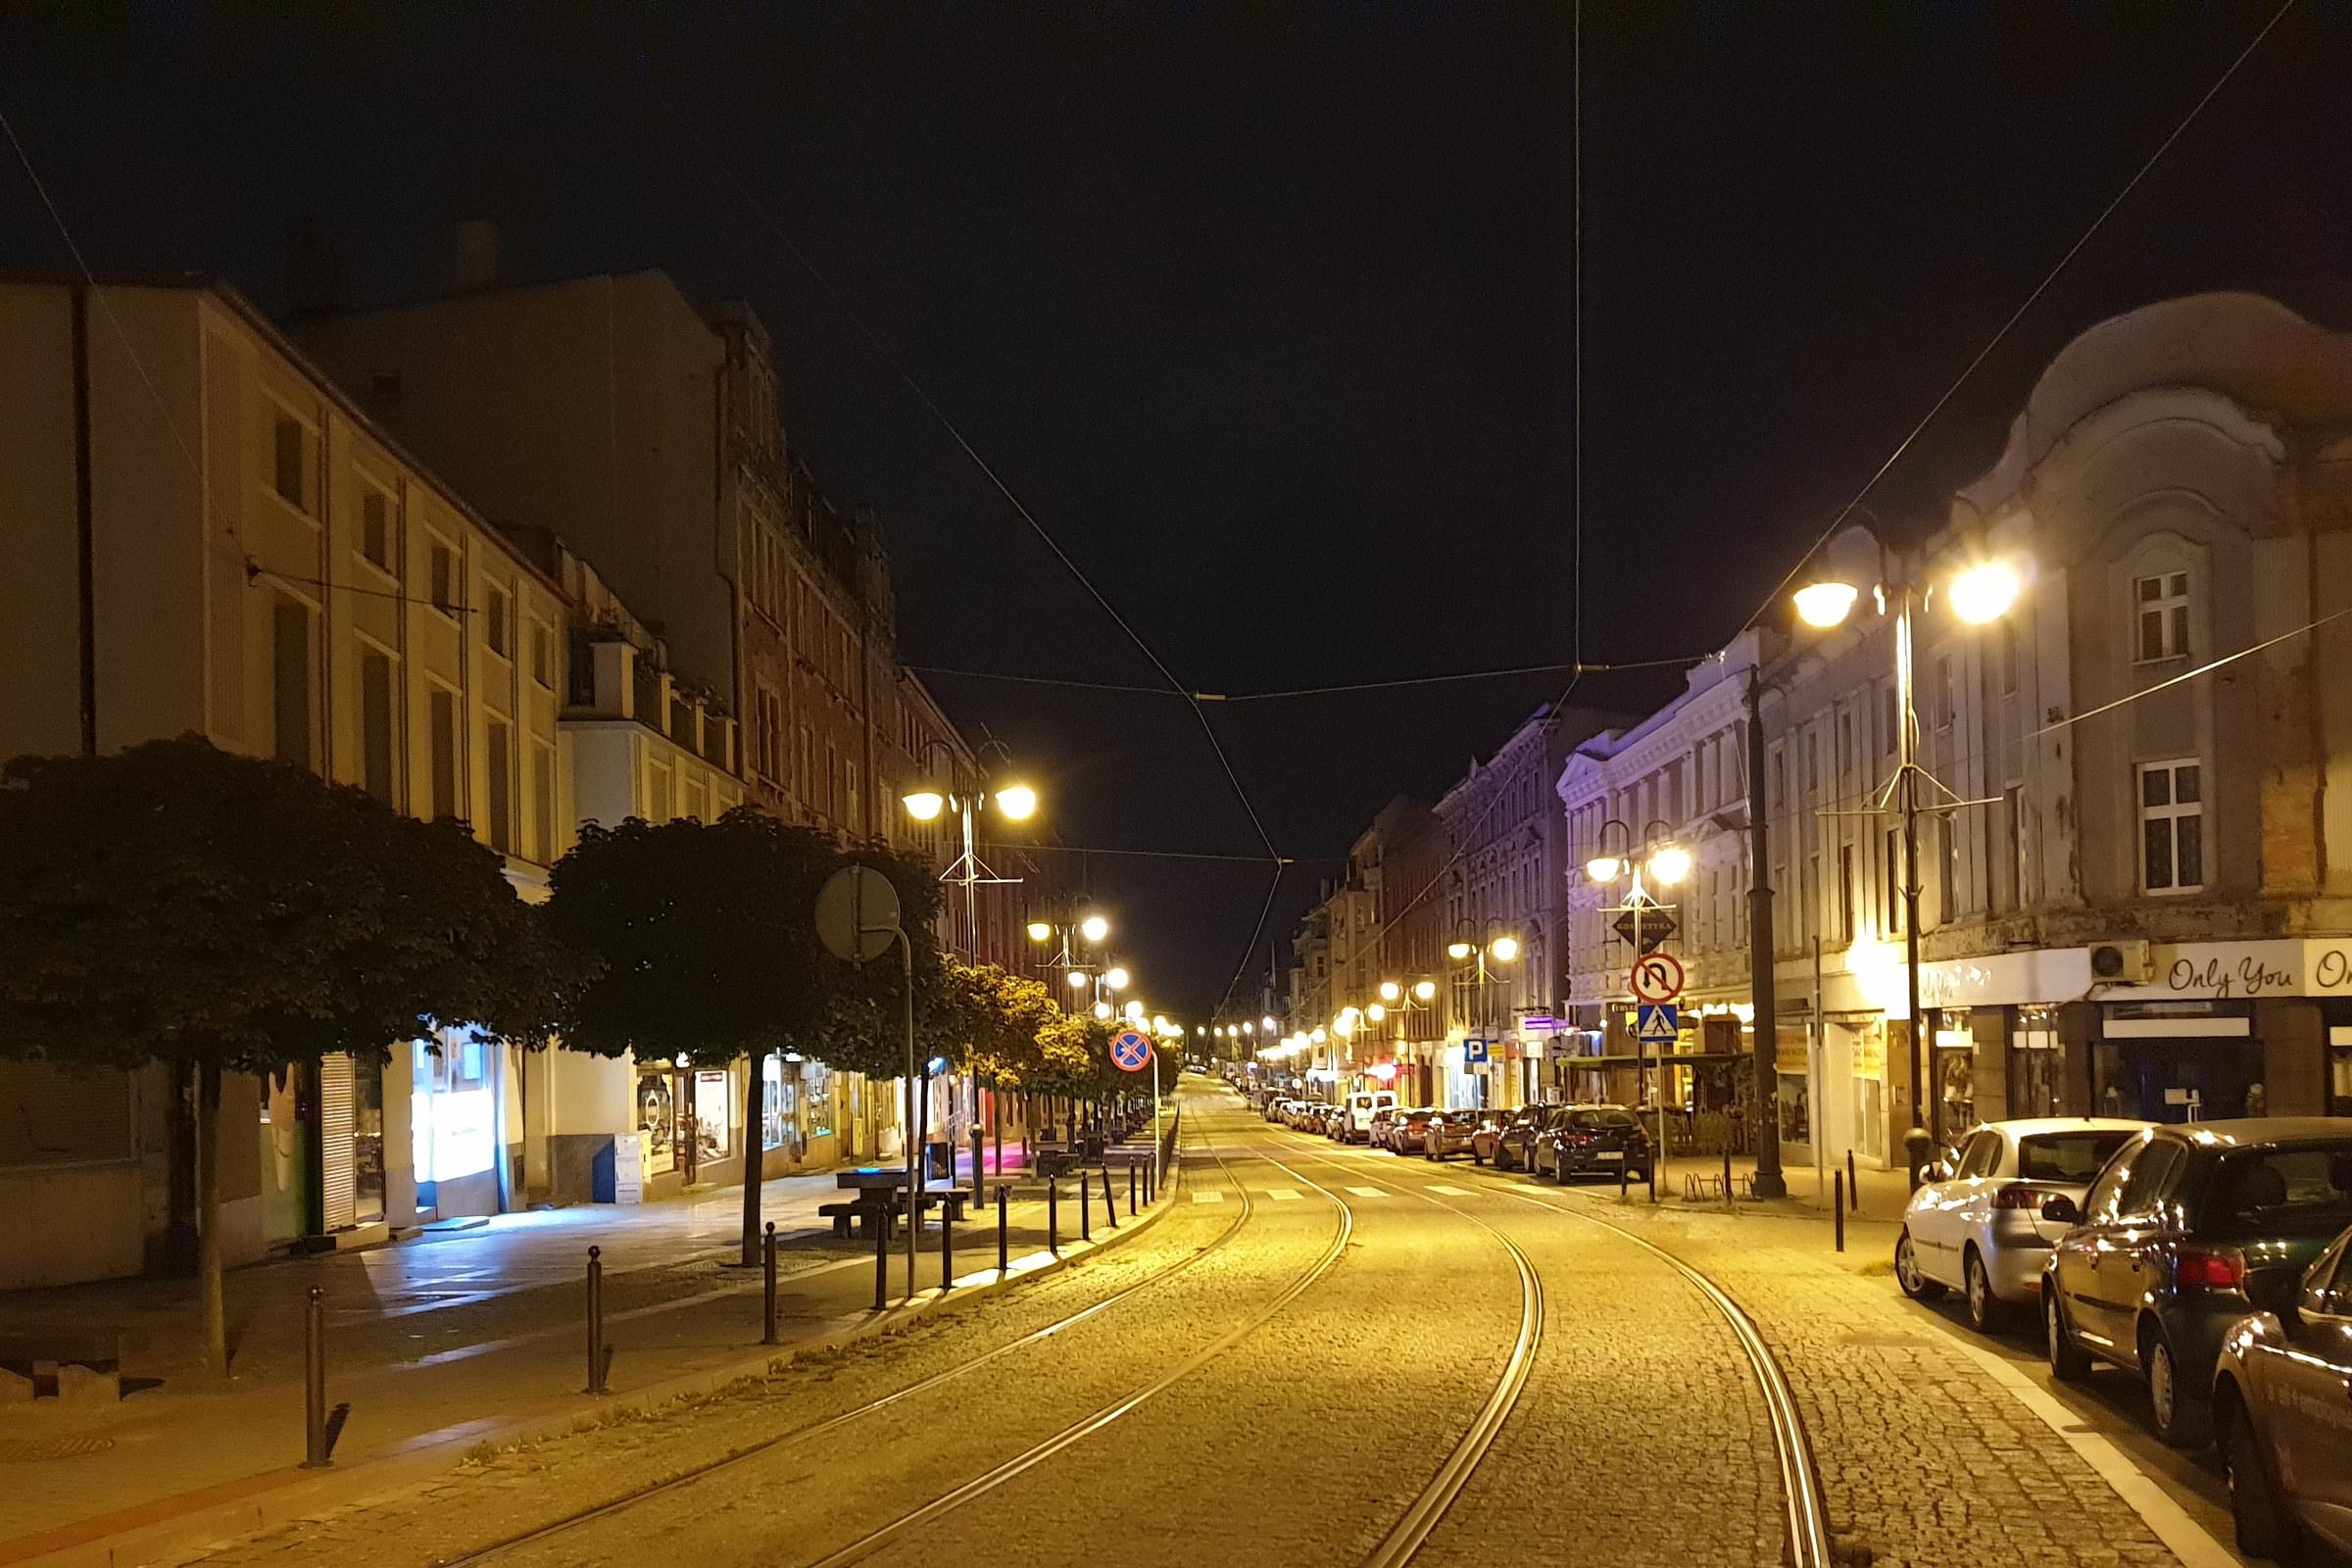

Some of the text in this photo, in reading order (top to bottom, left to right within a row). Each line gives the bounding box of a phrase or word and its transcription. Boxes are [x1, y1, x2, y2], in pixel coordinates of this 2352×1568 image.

[2169, 956, 2293, 998] Only You
[1468, 1041, 1483, 1060] P
